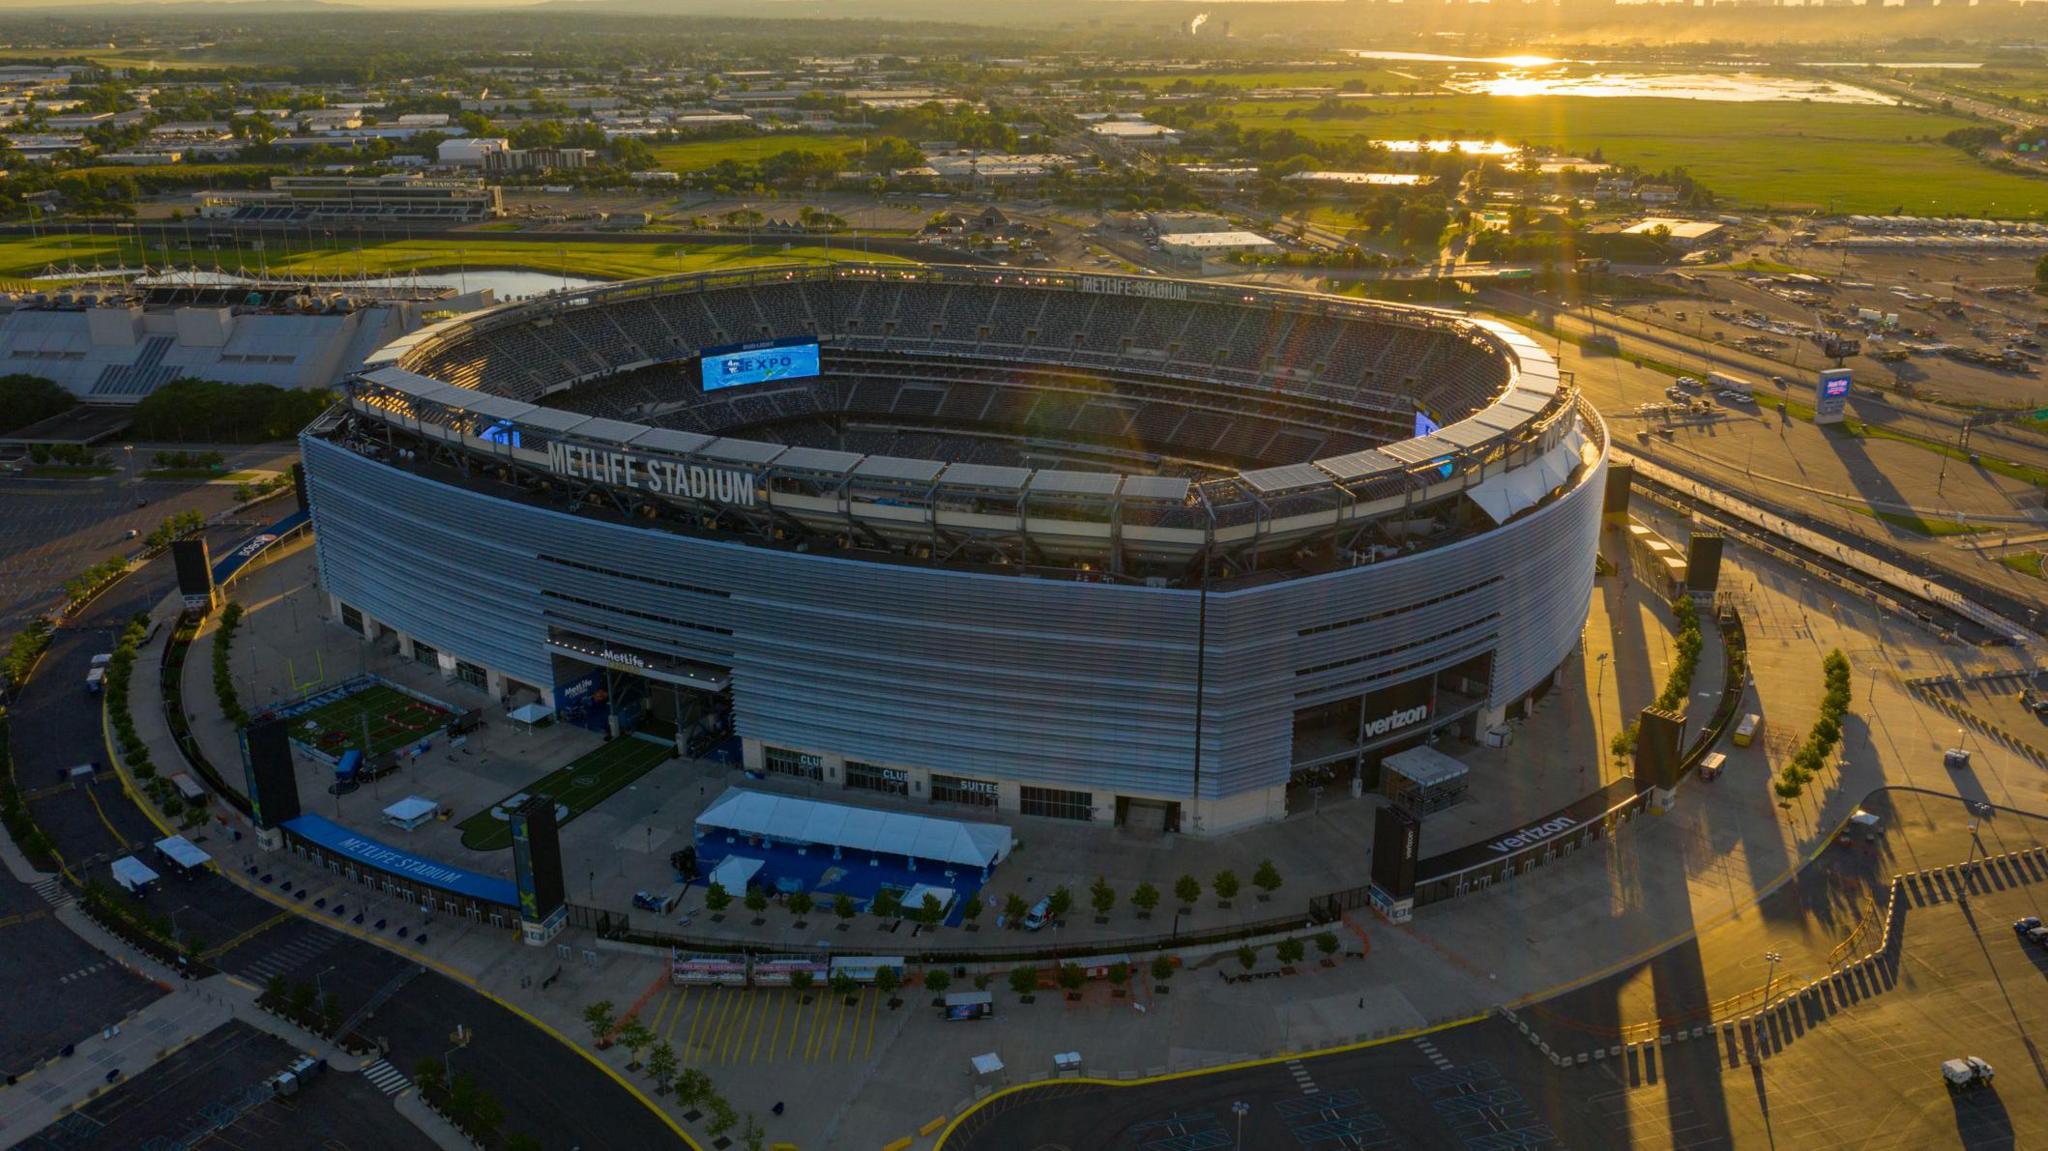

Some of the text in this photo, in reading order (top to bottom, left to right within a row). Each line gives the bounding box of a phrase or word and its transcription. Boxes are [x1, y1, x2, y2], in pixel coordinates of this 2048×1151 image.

[1082, 276, 1187, 300] METLIFE STADIUM
[744, 357, 791, 371] EXPO
[548, 441, 755, 506] METLIFE STADIUM
[604, 649, 644, 668] MetLife
[564, 679, 592, 697] MetLife
[1365, 705, 1427, 737] verizon
[1488, 816, 1577, 852] verizon
[338, 838, 463, 883] METLIFE STADIUM
